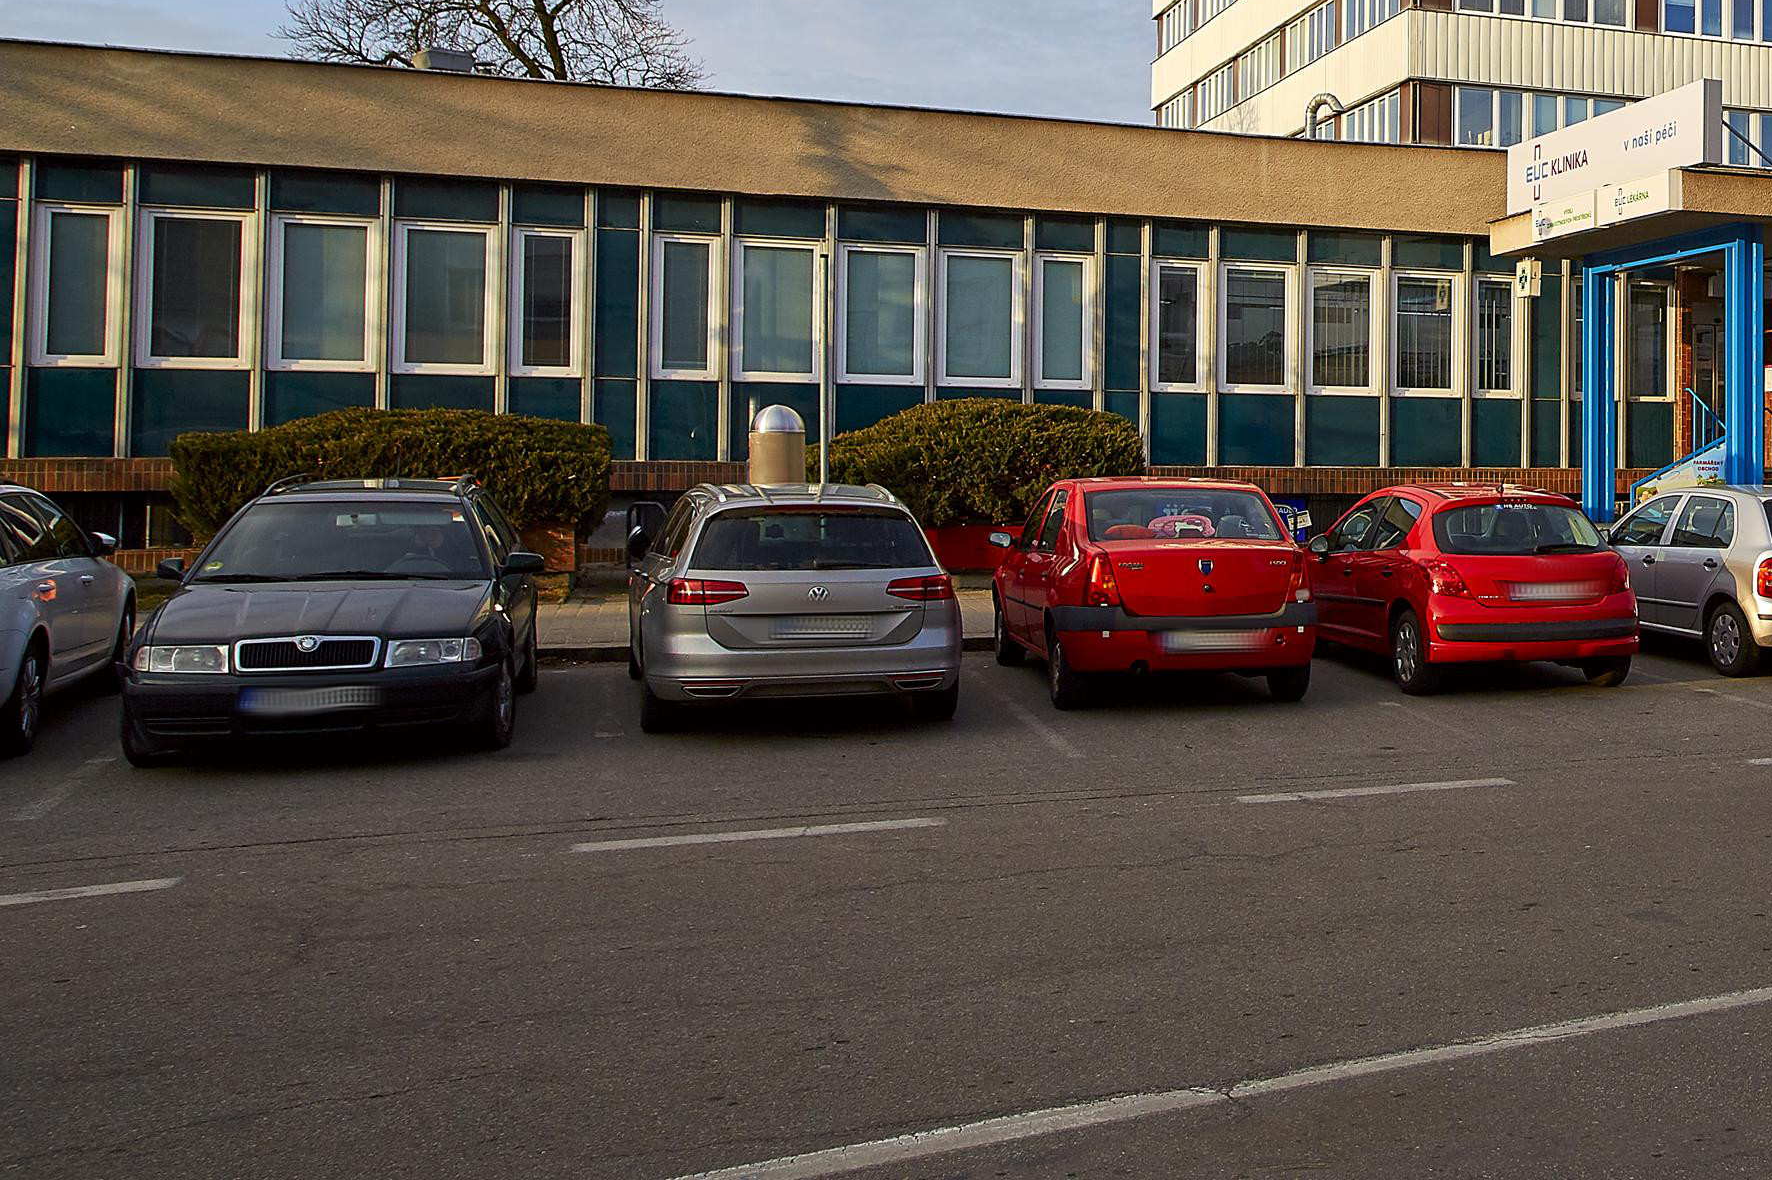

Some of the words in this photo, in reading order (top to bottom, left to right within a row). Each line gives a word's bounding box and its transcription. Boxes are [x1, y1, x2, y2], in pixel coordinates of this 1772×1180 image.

[1624, 140, 1630, 152] v
[1632, 129, 1652, 149] naší
[1655, 120, 1678, 145] péči
[1526, 161, 1549, 183] EUC
[1551, 149, 1588, 176] KLINIKA
